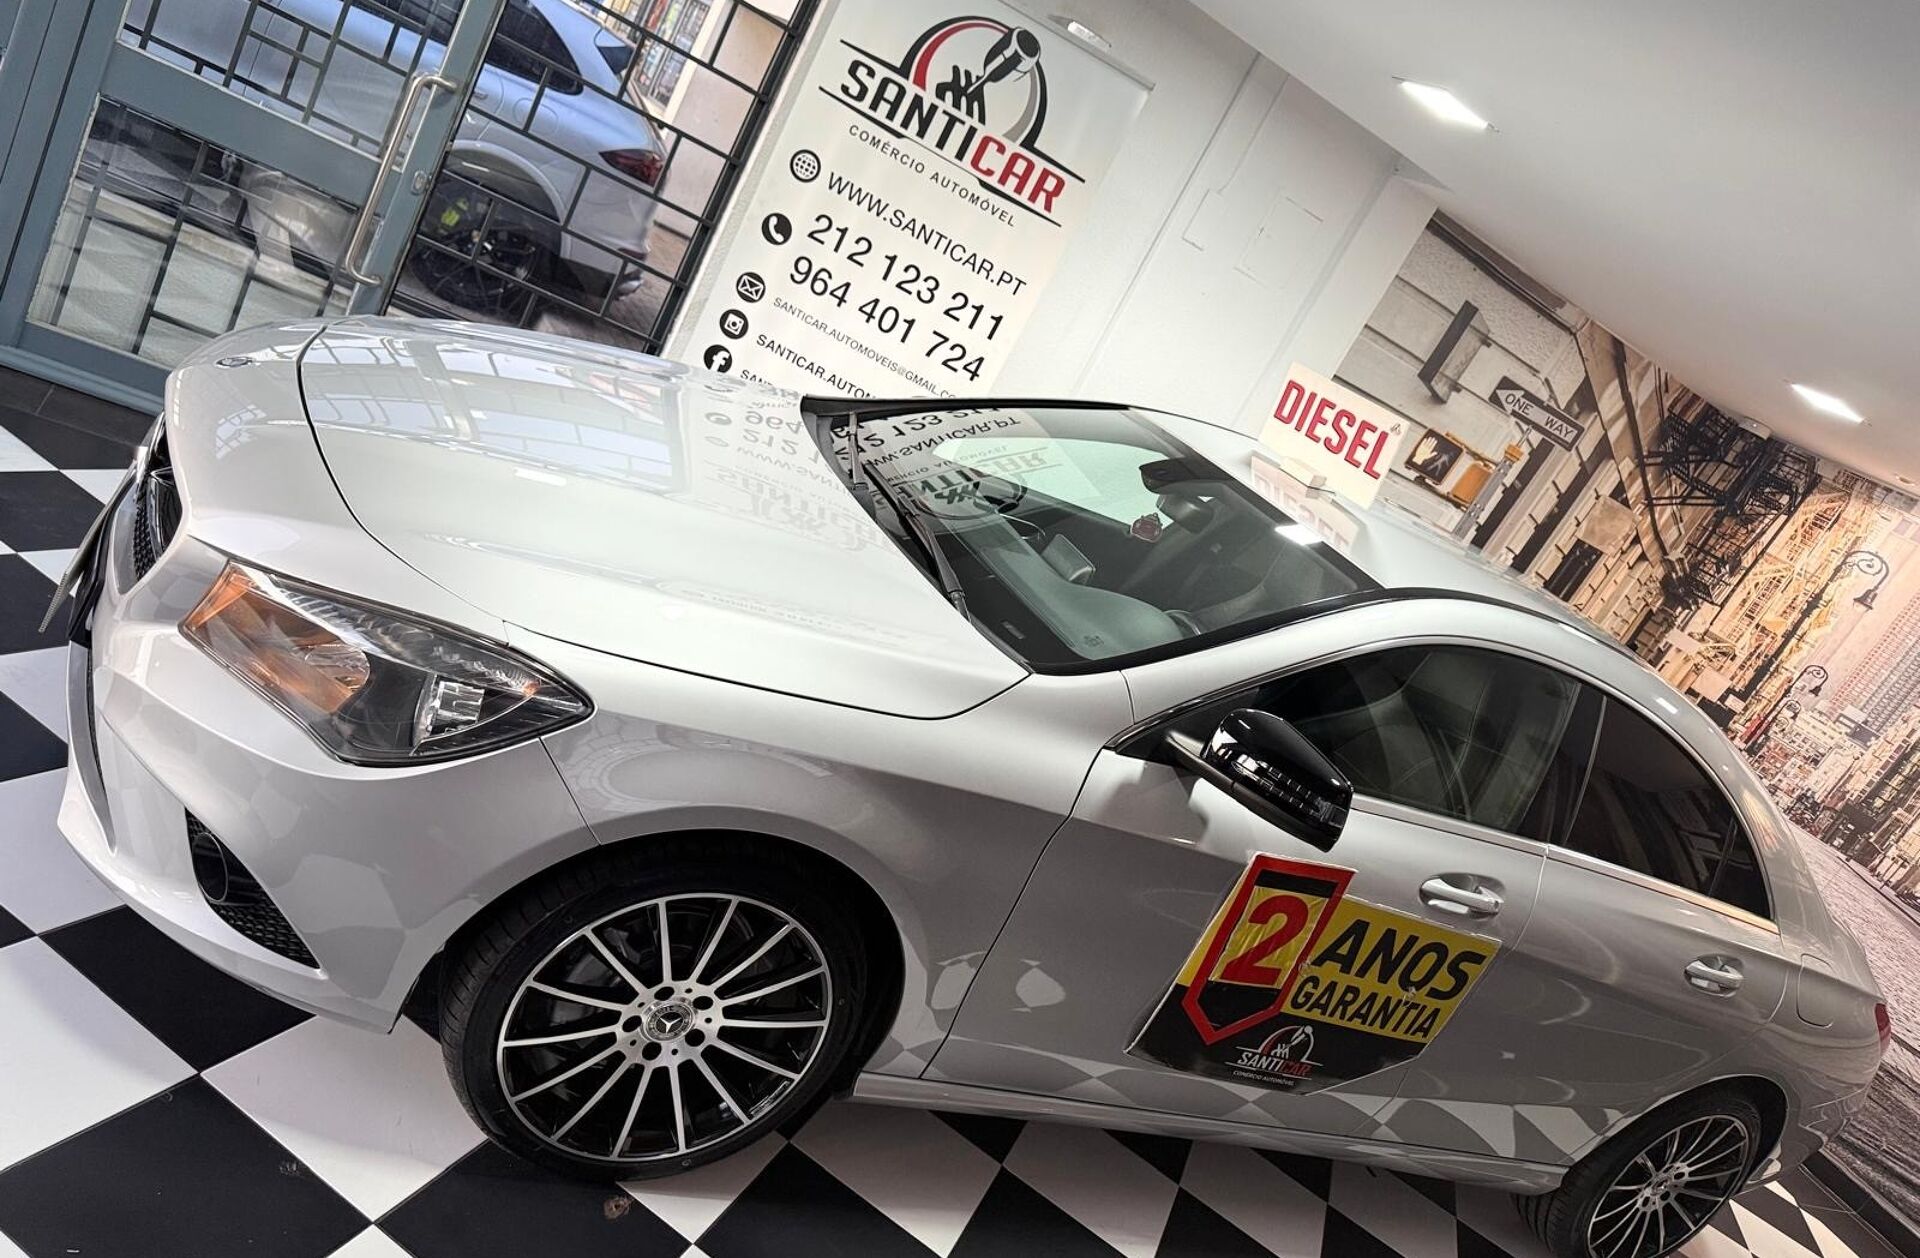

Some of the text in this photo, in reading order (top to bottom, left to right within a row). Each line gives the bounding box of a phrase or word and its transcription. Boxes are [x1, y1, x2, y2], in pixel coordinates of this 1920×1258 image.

[840, 60, 1066, 213] SANTICAR
[849, 124, 1015, 227] COMÉRCIO AUTOMÓVEL
[806, 213, 1005, 342] 212 123 211
[826, 170, 1027, 295] WWW.SANTICAR.PT
[789, 256, 986, 382] 964 401 724
[1273, 379, 1391, 480] DIESEL
[1504, 392, 1574, 439] ONE WAY
[1220, 895, 1486, 1001] 2 ANOS
[1290, 975, 1441, 1039] GARANTIA
